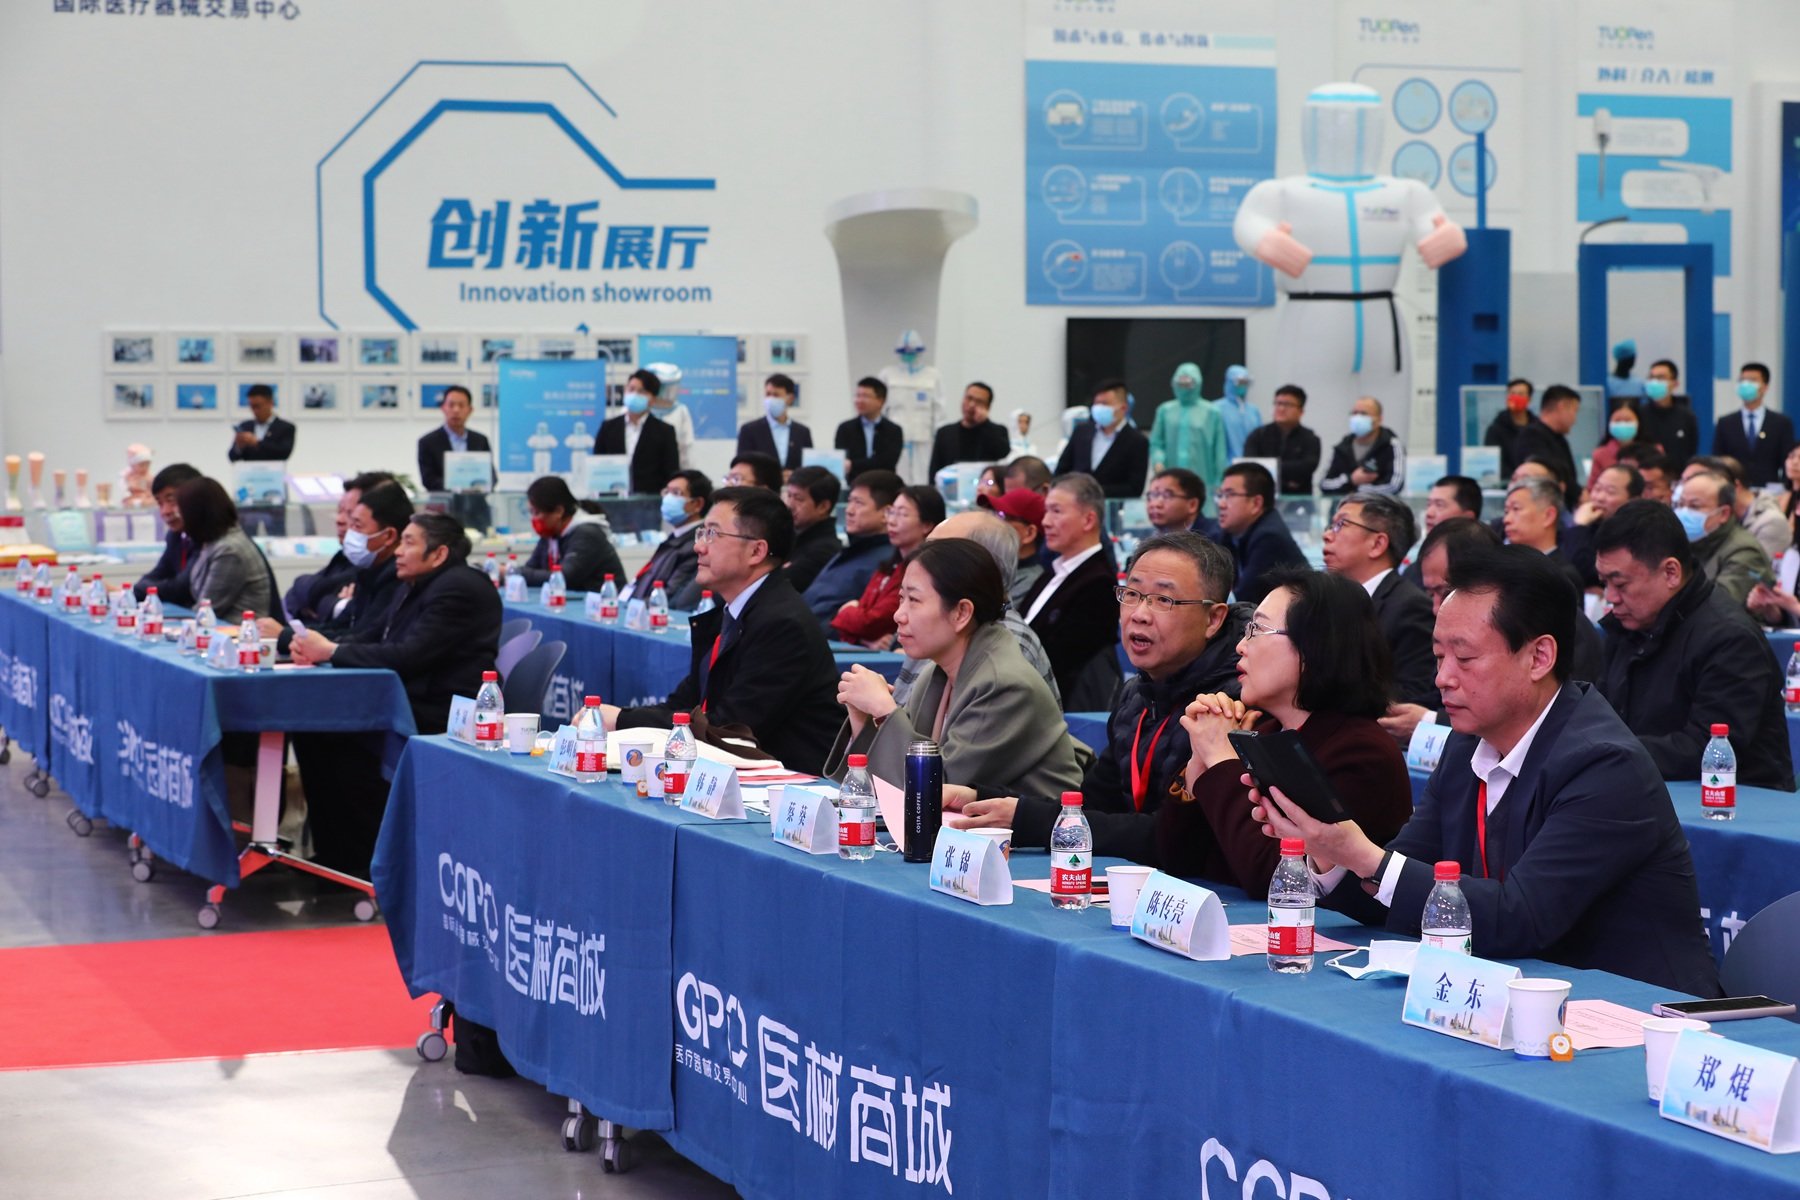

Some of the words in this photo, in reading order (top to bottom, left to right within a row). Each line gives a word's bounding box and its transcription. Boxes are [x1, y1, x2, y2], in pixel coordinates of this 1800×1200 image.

[53, 0, 300, 20] 国际医疗器械交易中心
[427, 198, 710, 270] 创新展厅
[459, 281, 585, 302] Innovation
[592, 281, 712, 302] showroom
[944, 845, 972, 873] 张锦
[1145, 890, 1190, 926] 陈传亮
[505, 903, 606, 1020] 医械商城
[757, 1014, 953, 1195] 医械商城
